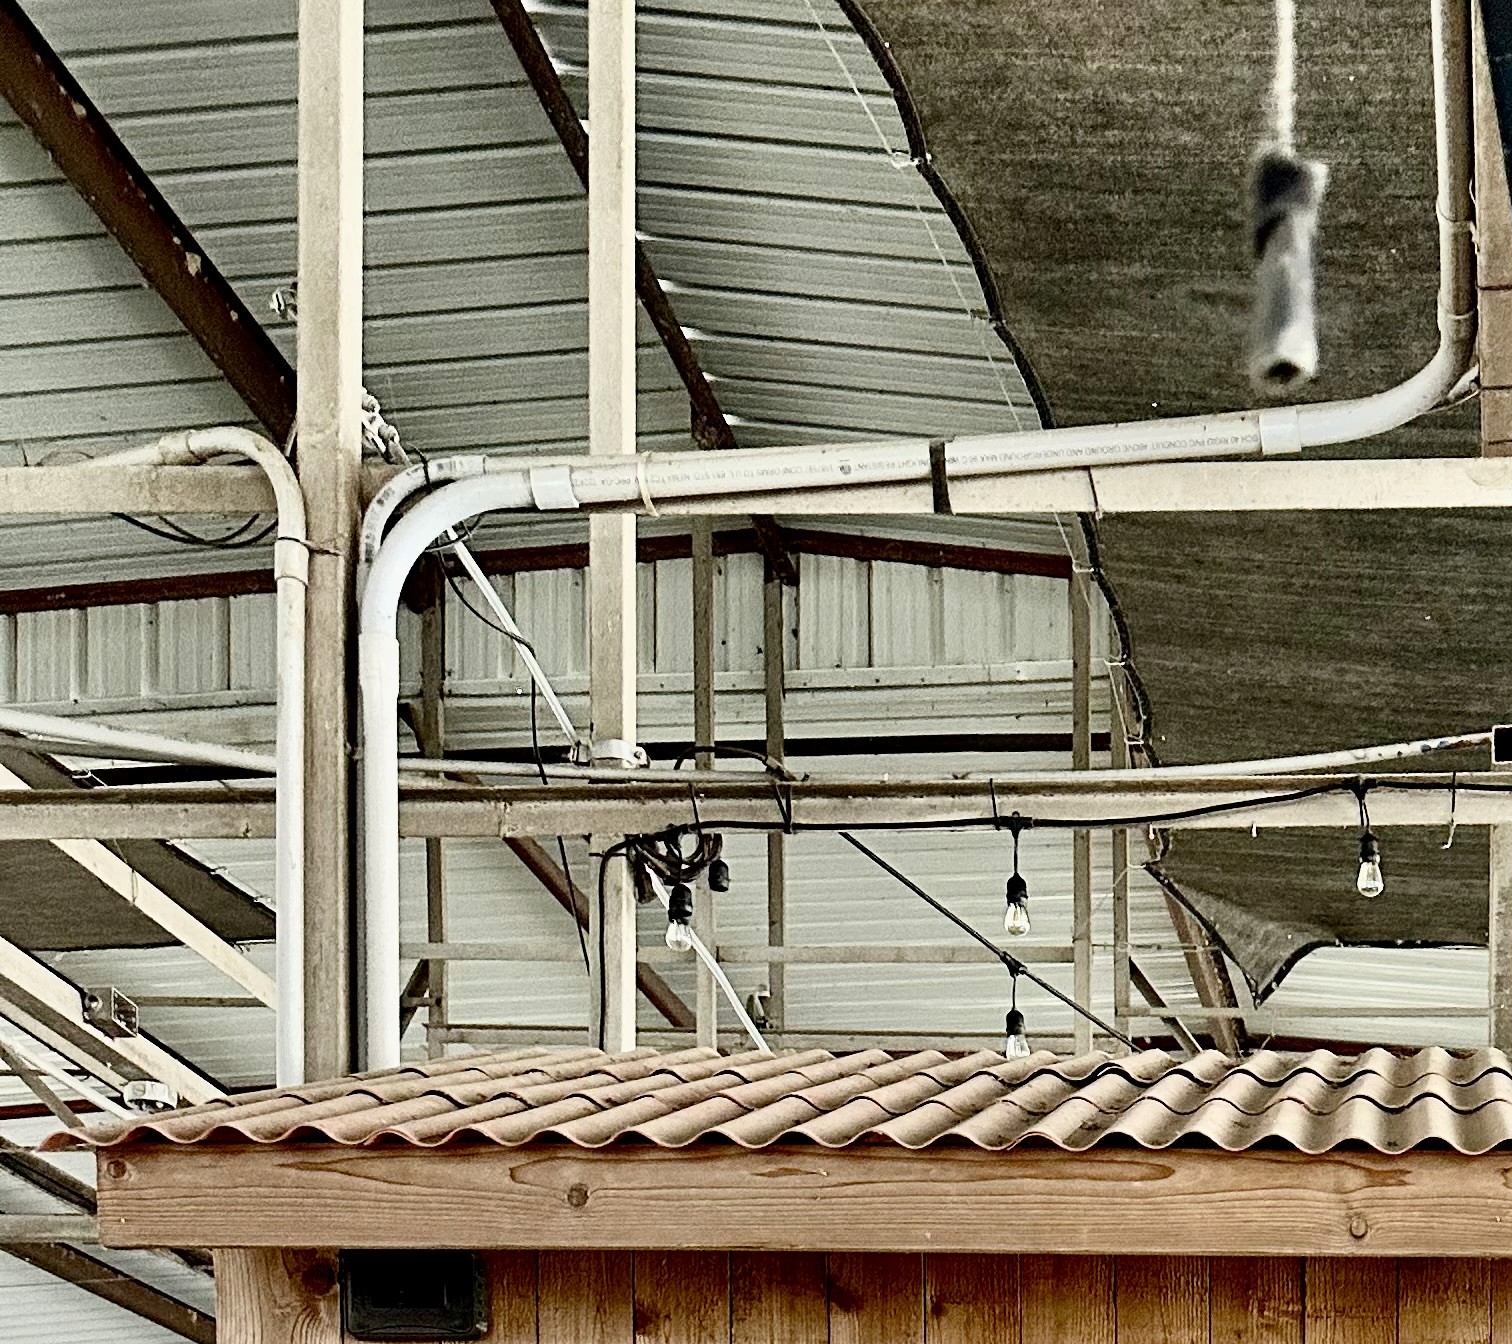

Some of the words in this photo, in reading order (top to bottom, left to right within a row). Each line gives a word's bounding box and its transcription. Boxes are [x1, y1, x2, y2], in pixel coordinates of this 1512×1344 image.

[1189, 438, 1206, 447] PVC
[998, 449, 1066, 461] UNDERGROUND
[1066, 447, 1084, 457] AND
[1085, 444, 1121, 456] GROUND
[979, 453, 998, 463] MAX
[853, 460, 896, 471] RESISTANT
[743, 469, 755, 479] TO
